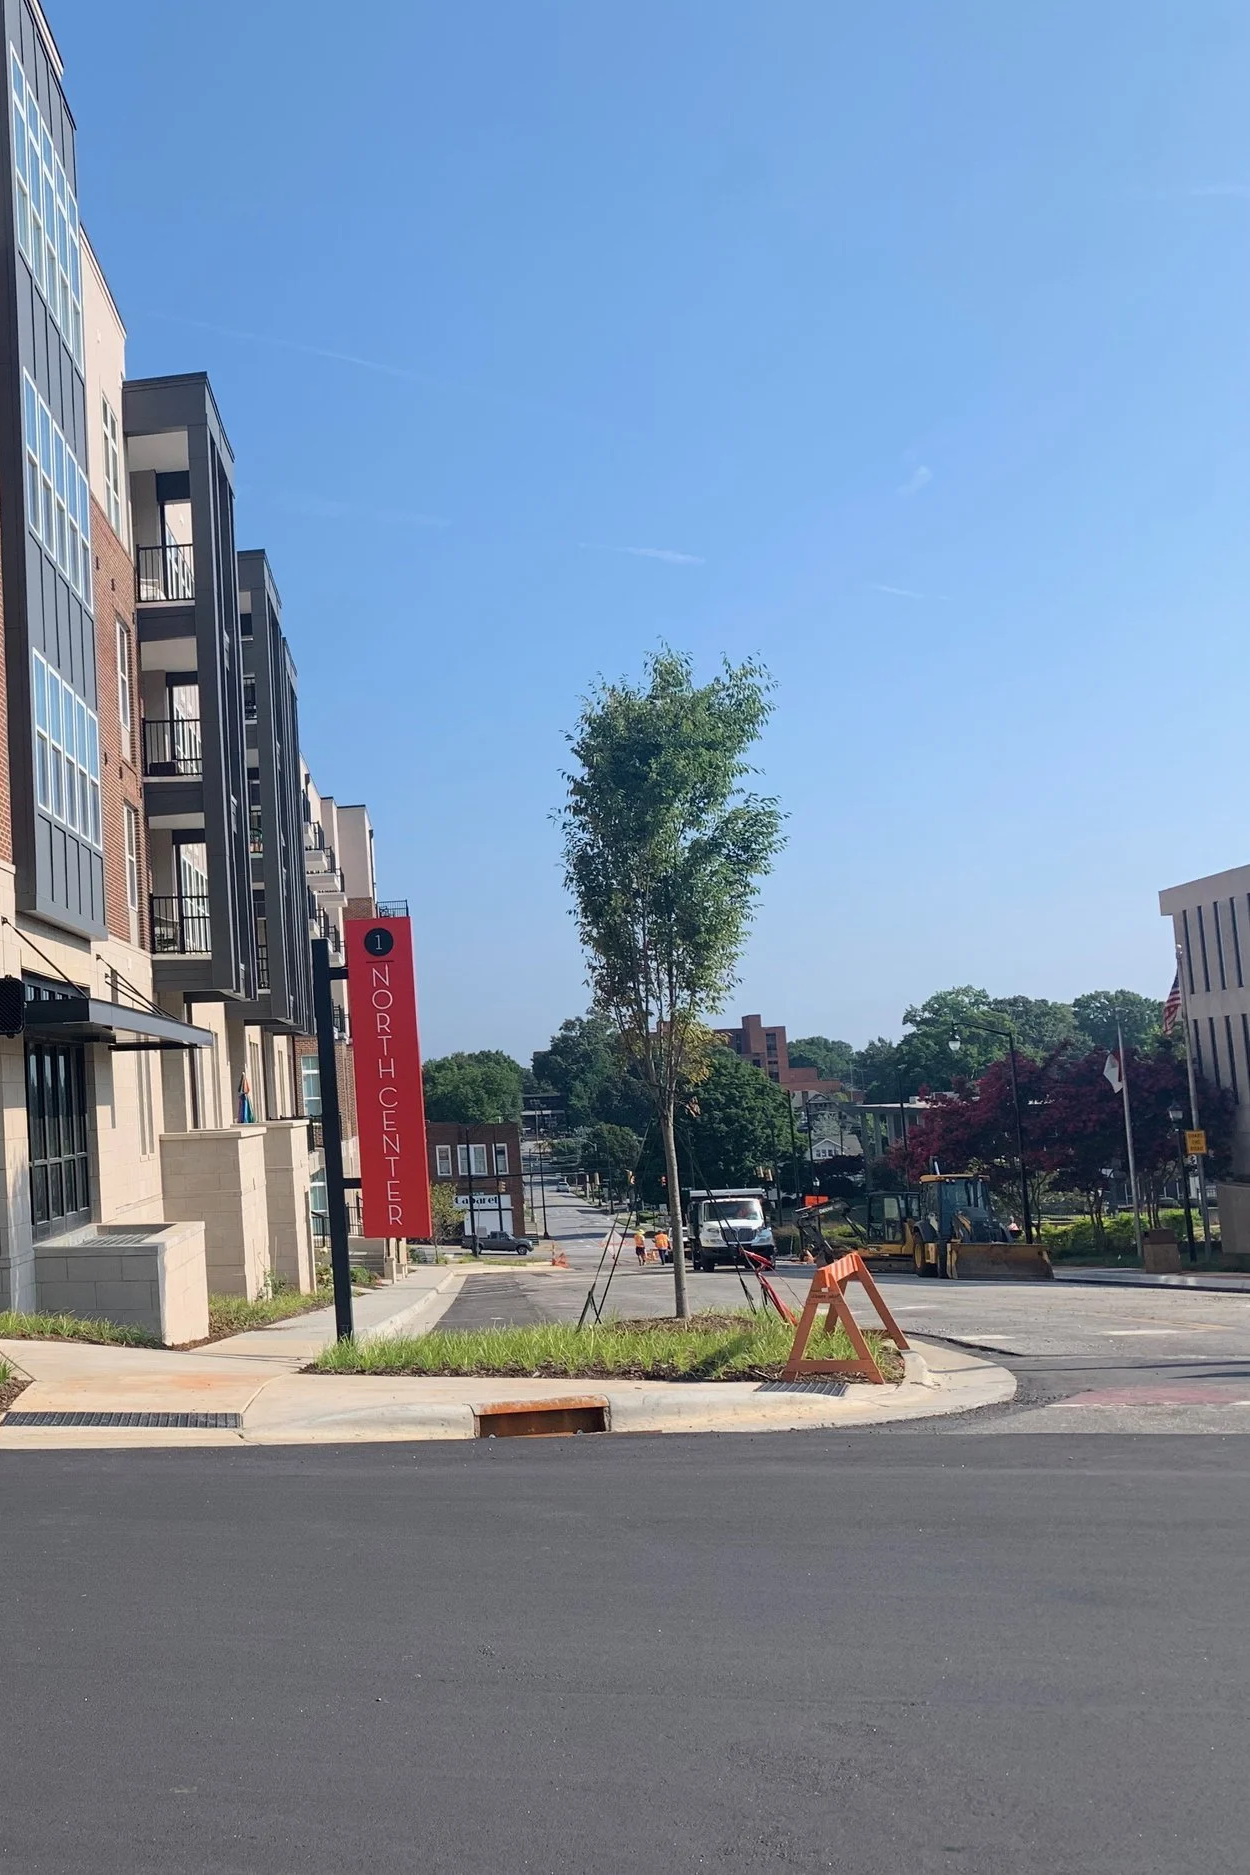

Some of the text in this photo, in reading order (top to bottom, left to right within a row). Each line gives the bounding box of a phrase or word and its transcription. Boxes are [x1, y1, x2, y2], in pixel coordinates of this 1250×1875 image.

[375, 934, 383, 950] 1
[371, 963, 403, 1226] NORTH CENTER
